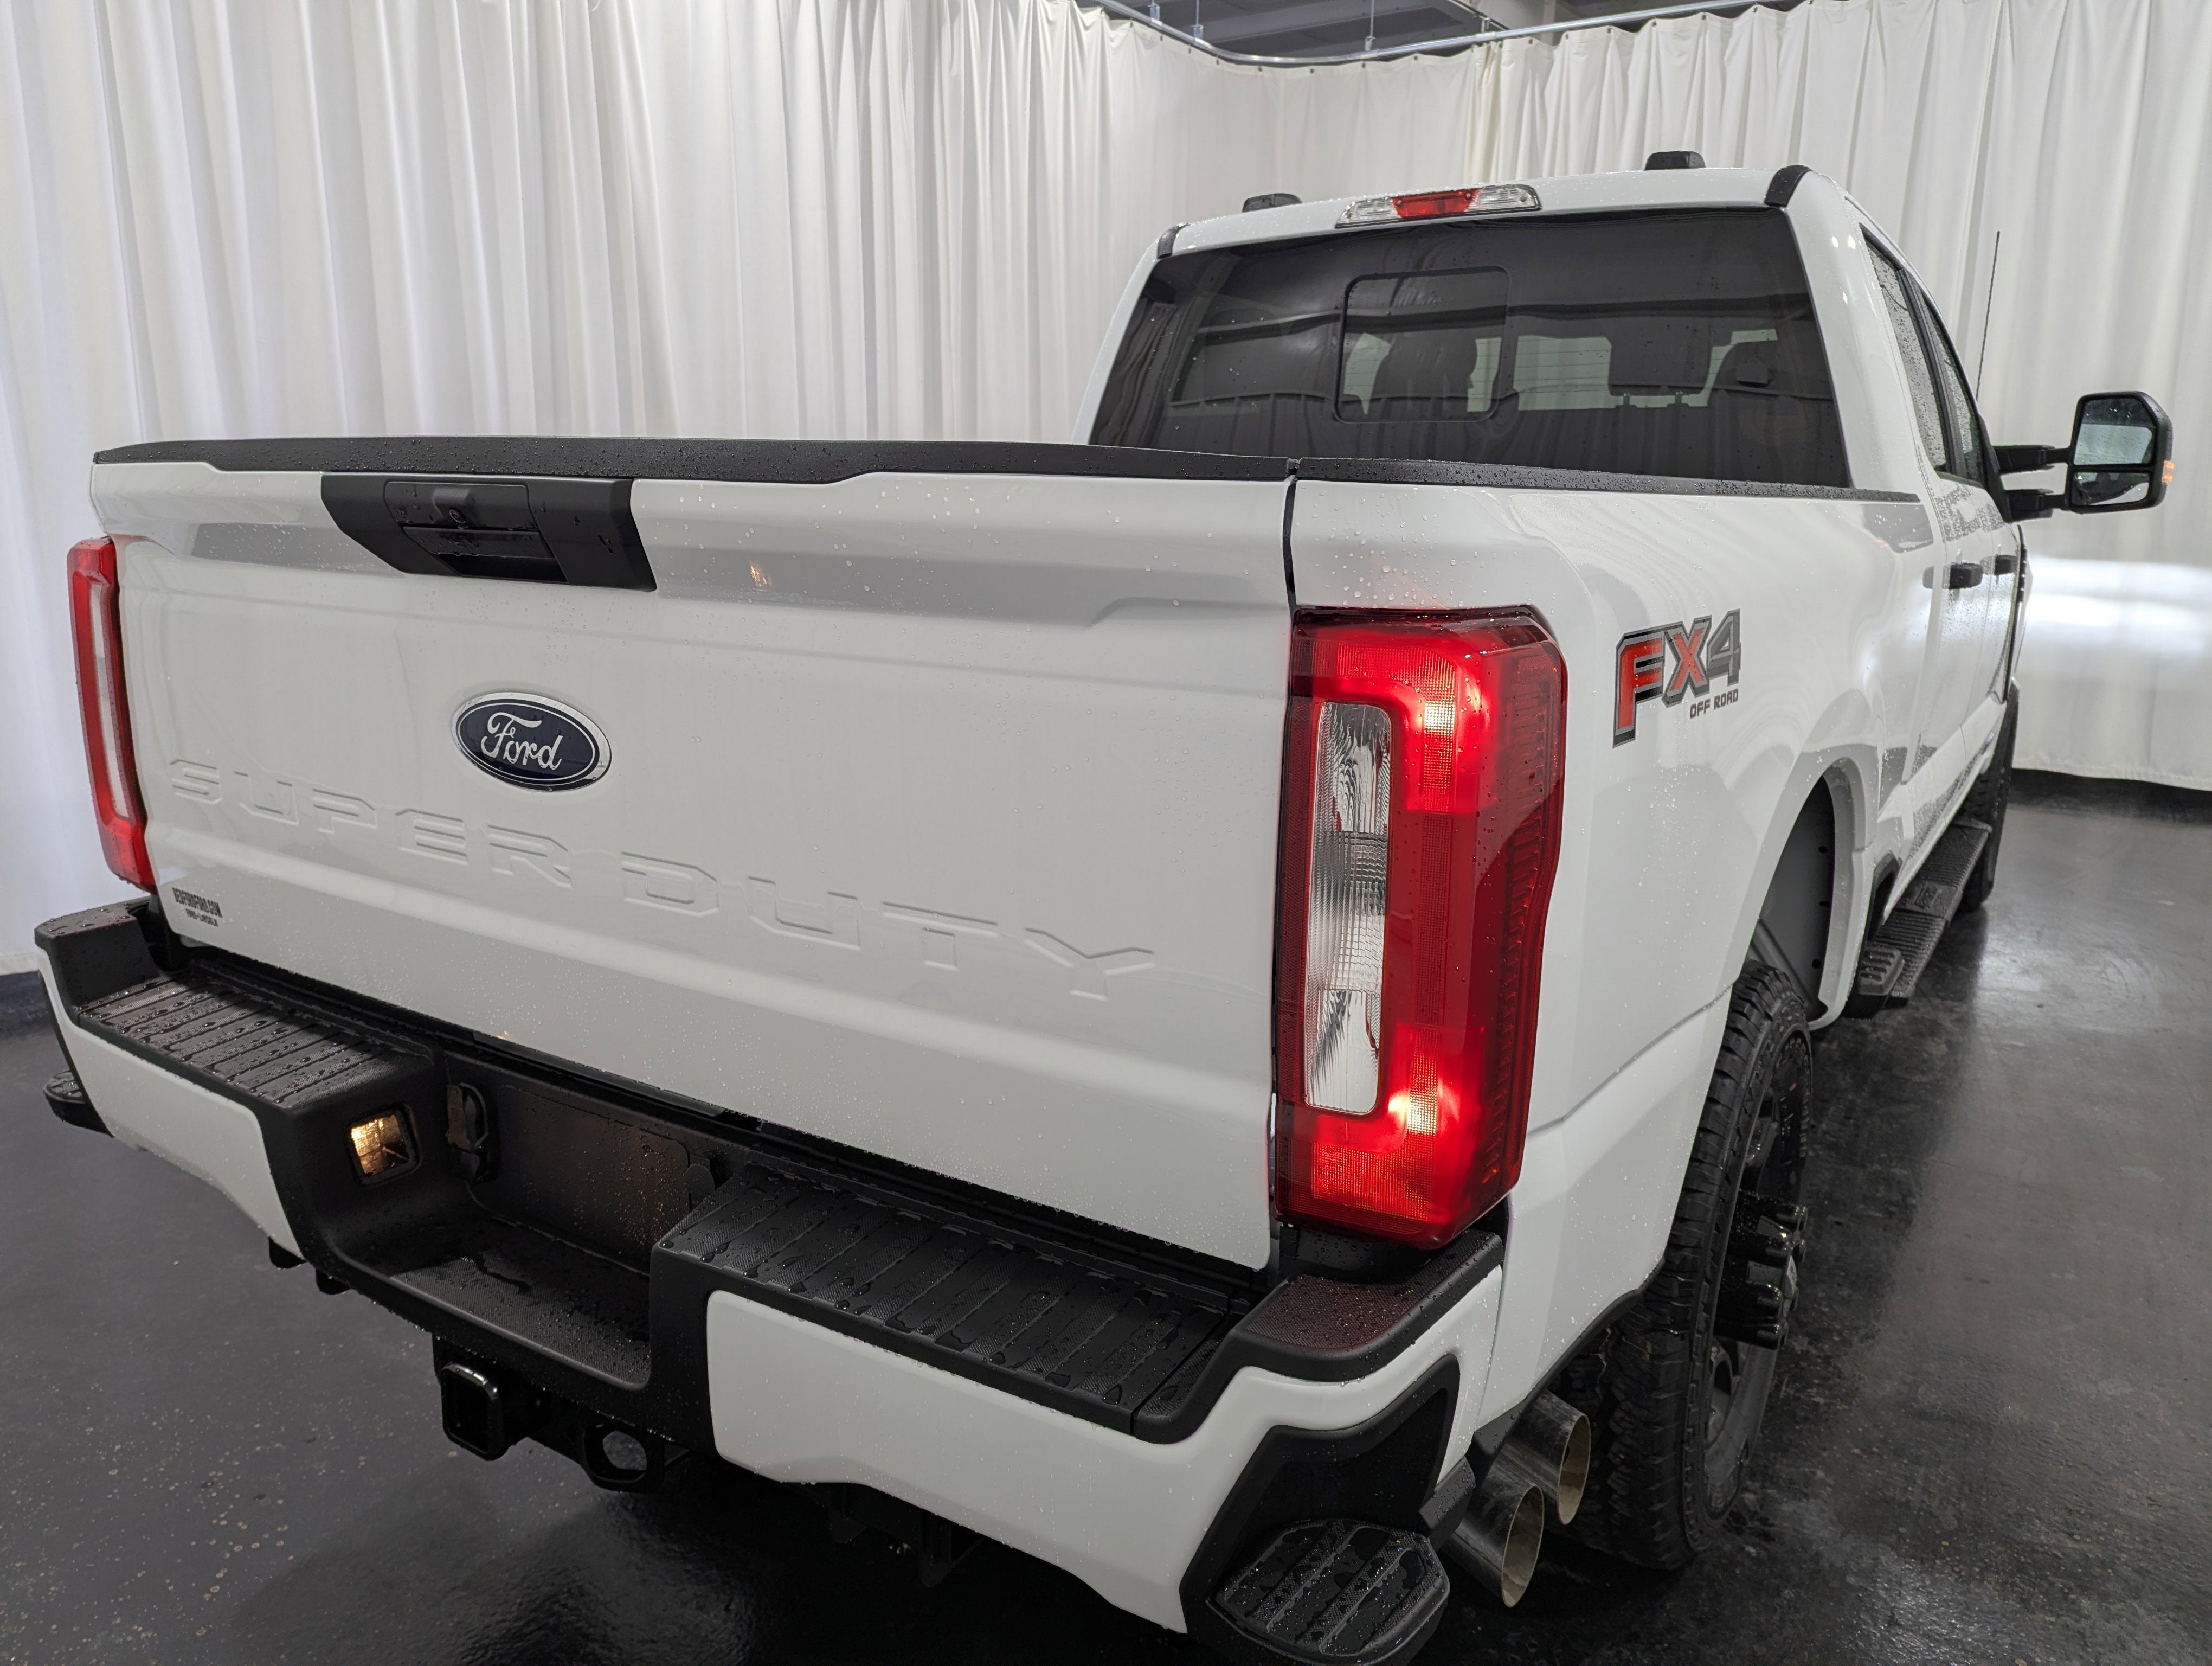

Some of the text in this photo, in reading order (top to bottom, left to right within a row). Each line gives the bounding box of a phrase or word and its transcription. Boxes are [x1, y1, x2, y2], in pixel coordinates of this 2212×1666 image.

[1612, 608, 1741, 748] FX4
[1690, 688, 1739, 719] OFF ROAD
[480, 712, 564, 770] Ford
[169, 759, 1155, 1001] SUPER DUTY
